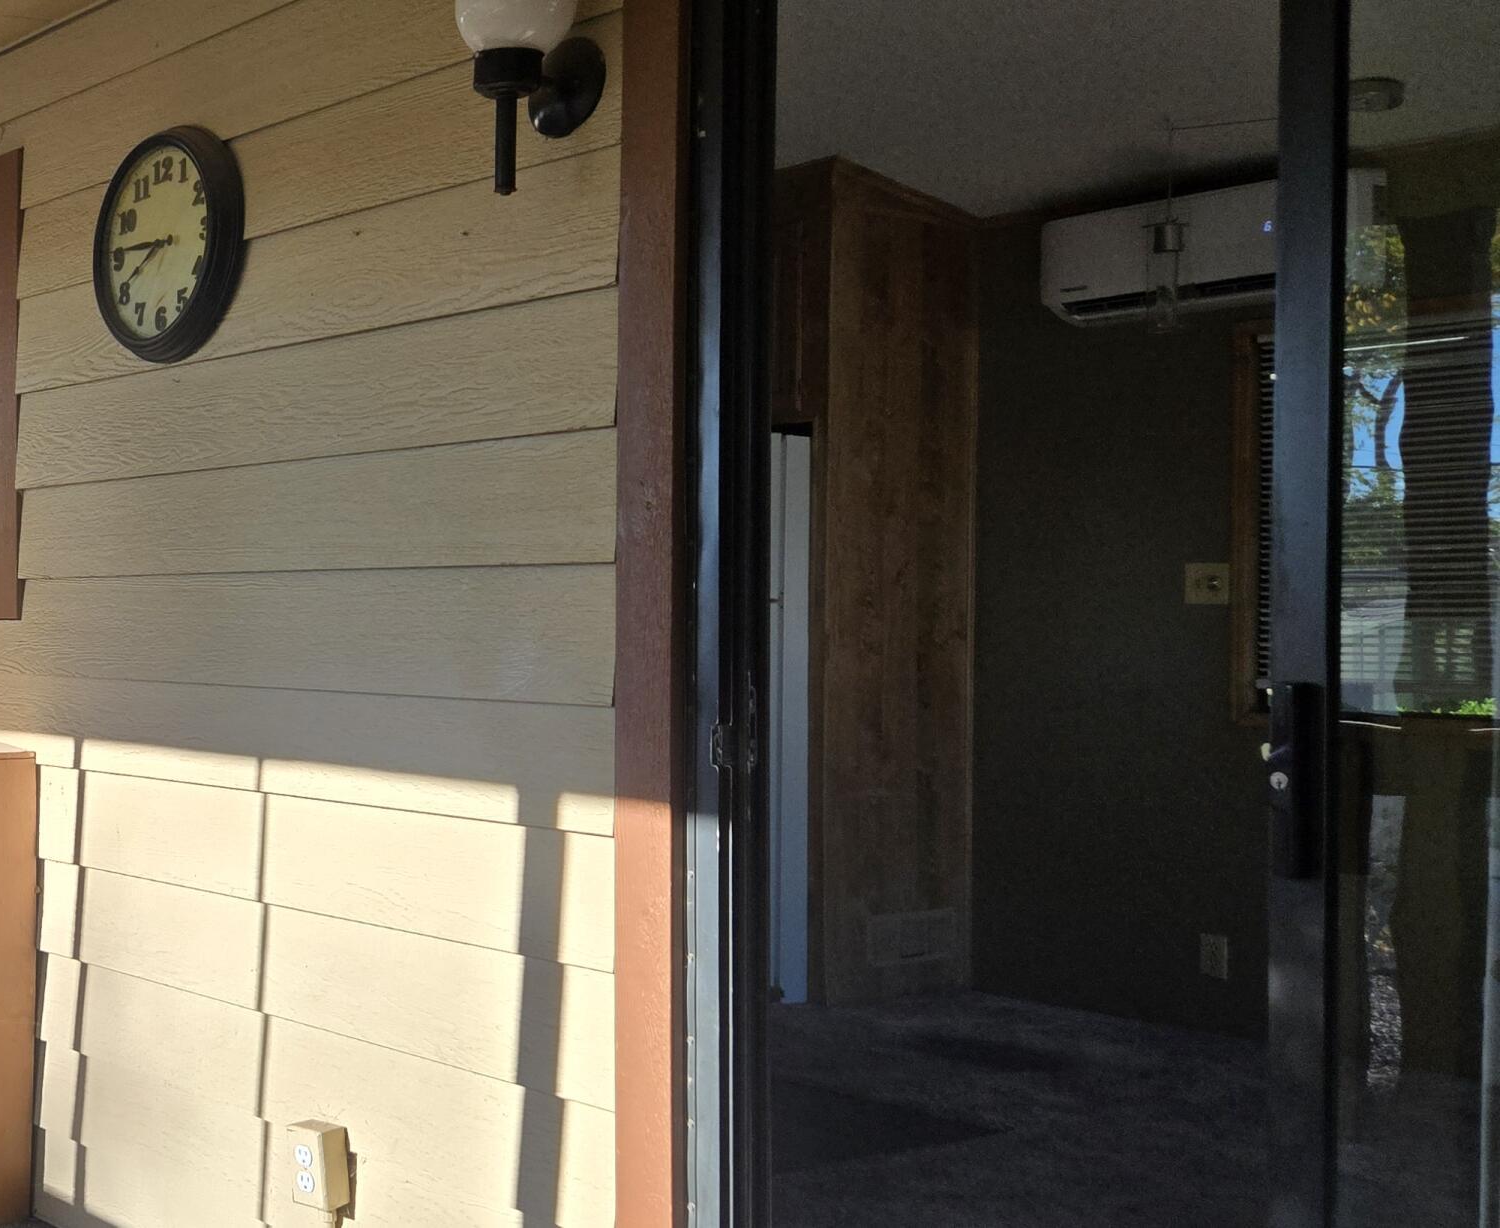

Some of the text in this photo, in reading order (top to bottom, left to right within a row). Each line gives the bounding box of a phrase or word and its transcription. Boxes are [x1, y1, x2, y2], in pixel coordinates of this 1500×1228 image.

[152, 156, 174, 186] 12
[178, 158, 188, 183] 1
[133, 175, 151, 204] 11
[192, 179, 205, 207] 2
[118, 208, 137, 236] 10
[113, 246, 125, 272] 9
[119, 281, 131, 306] 8
[176, 287, 188, 313] 5
[134, 302, 147, 327] 7
[154, 306, 168, 332] 6
